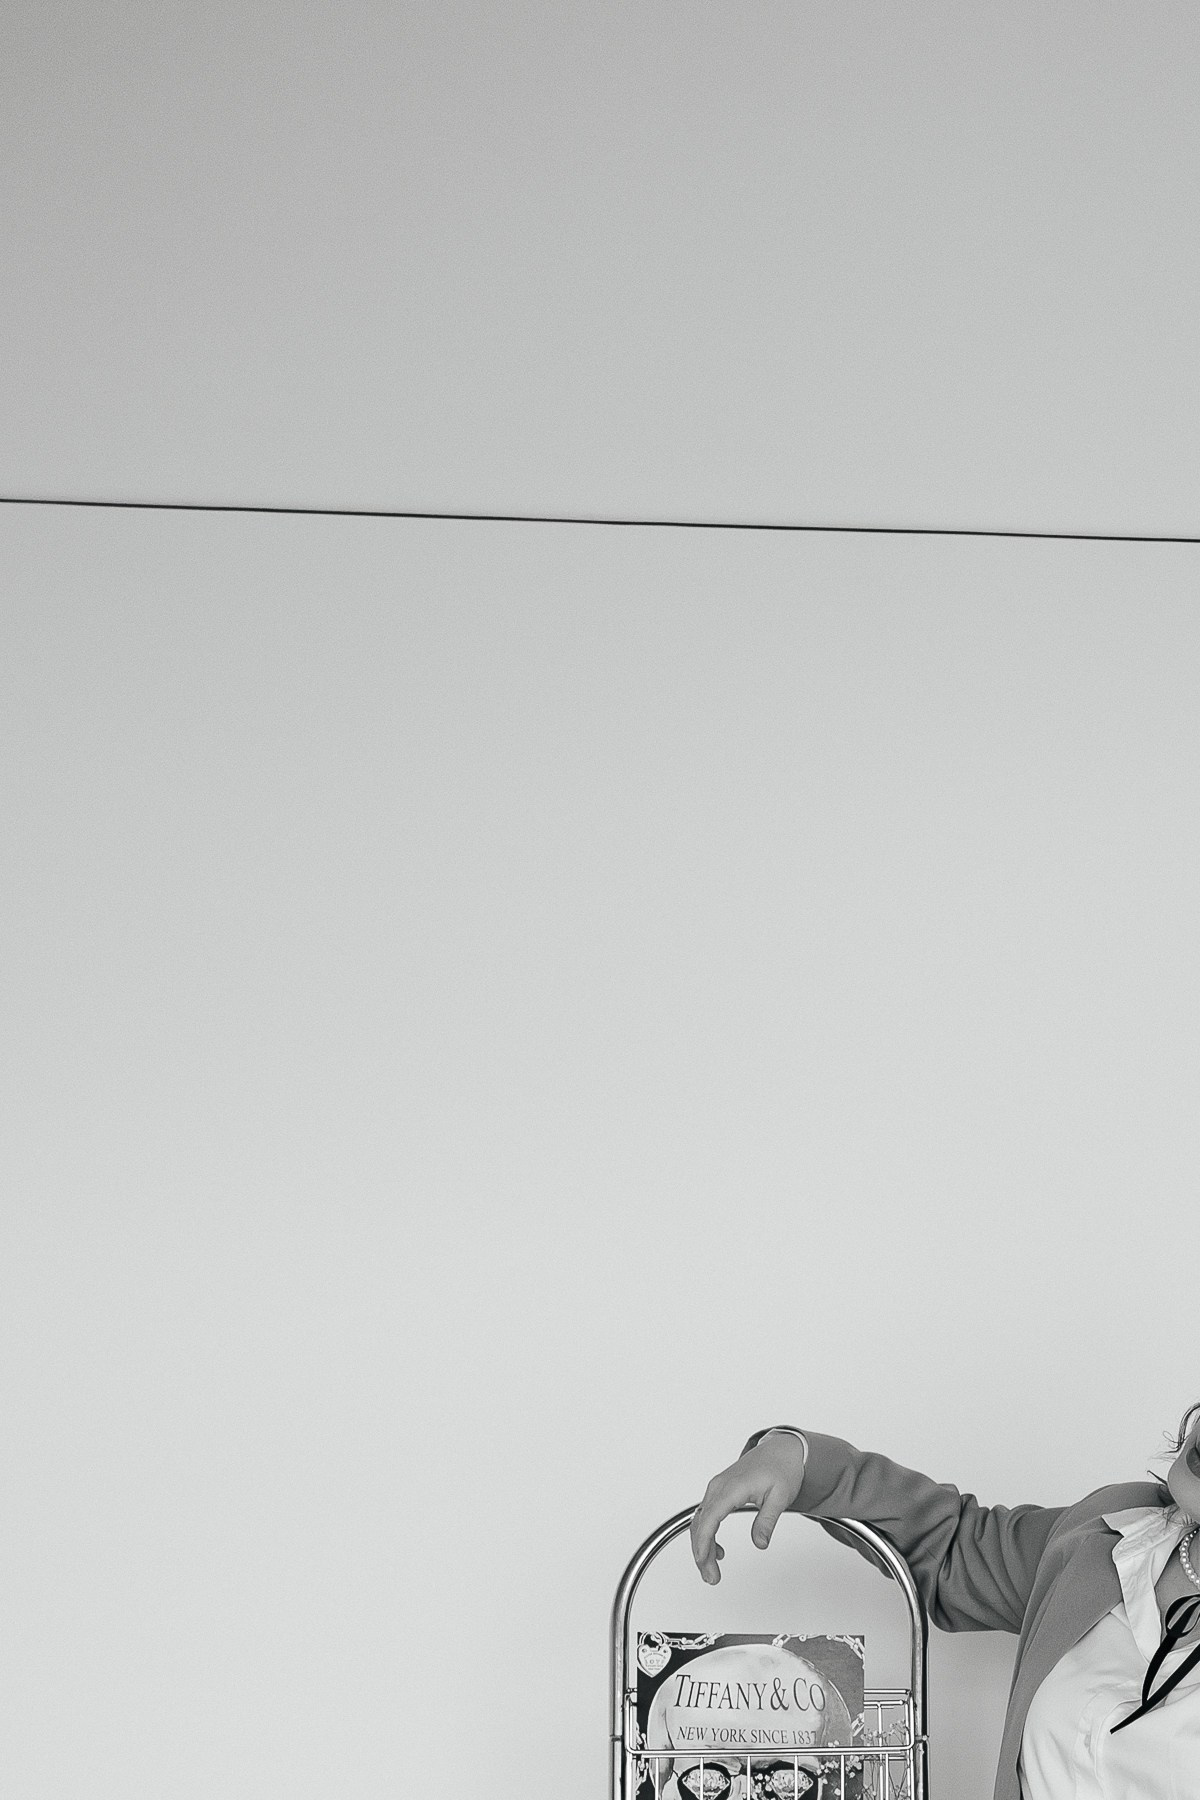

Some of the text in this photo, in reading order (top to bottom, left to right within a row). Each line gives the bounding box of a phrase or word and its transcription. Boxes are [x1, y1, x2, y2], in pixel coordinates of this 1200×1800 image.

[673, 1674, 767, 1711] TIFFANY
[676, 1726, 816, 1745] NEW YORK SINCE 1837
